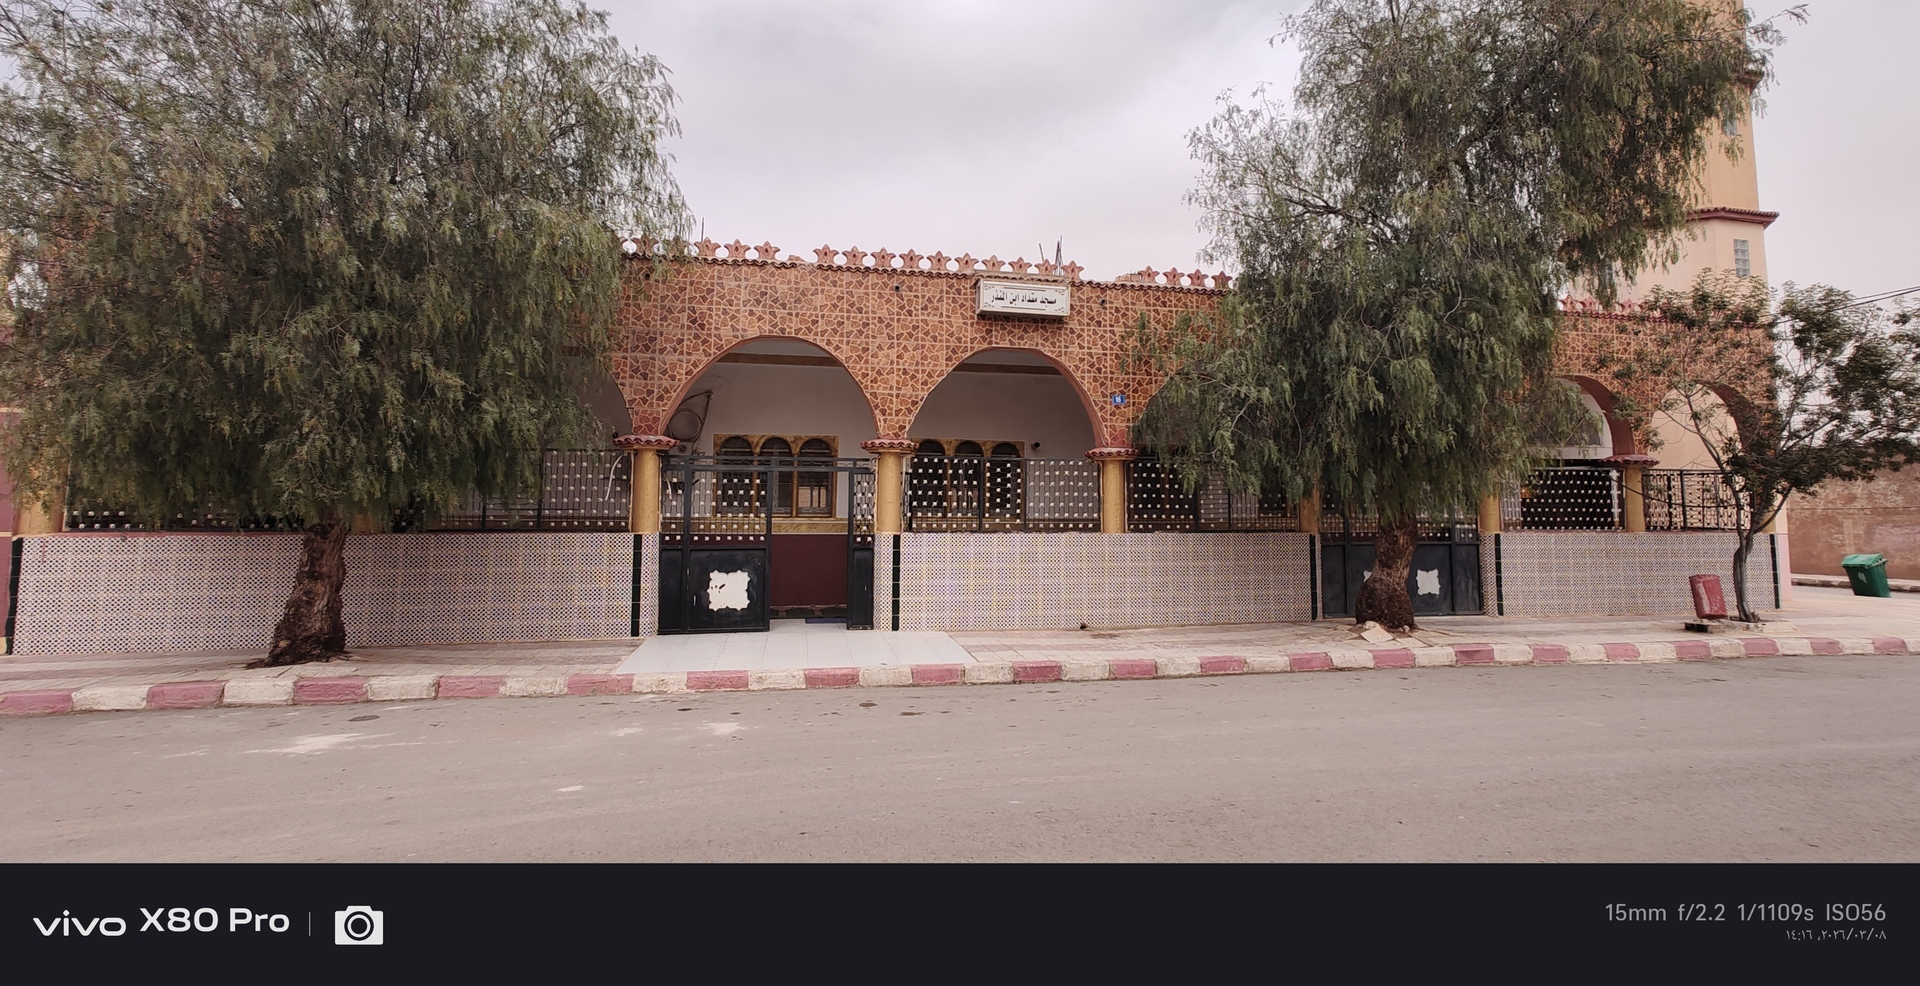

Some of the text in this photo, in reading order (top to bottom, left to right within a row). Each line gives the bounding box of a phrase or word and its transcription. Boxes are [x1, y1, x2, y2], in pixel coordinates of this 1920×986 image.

[991, 290, 1056, 307] مسجد مقداد ابن المنذر
